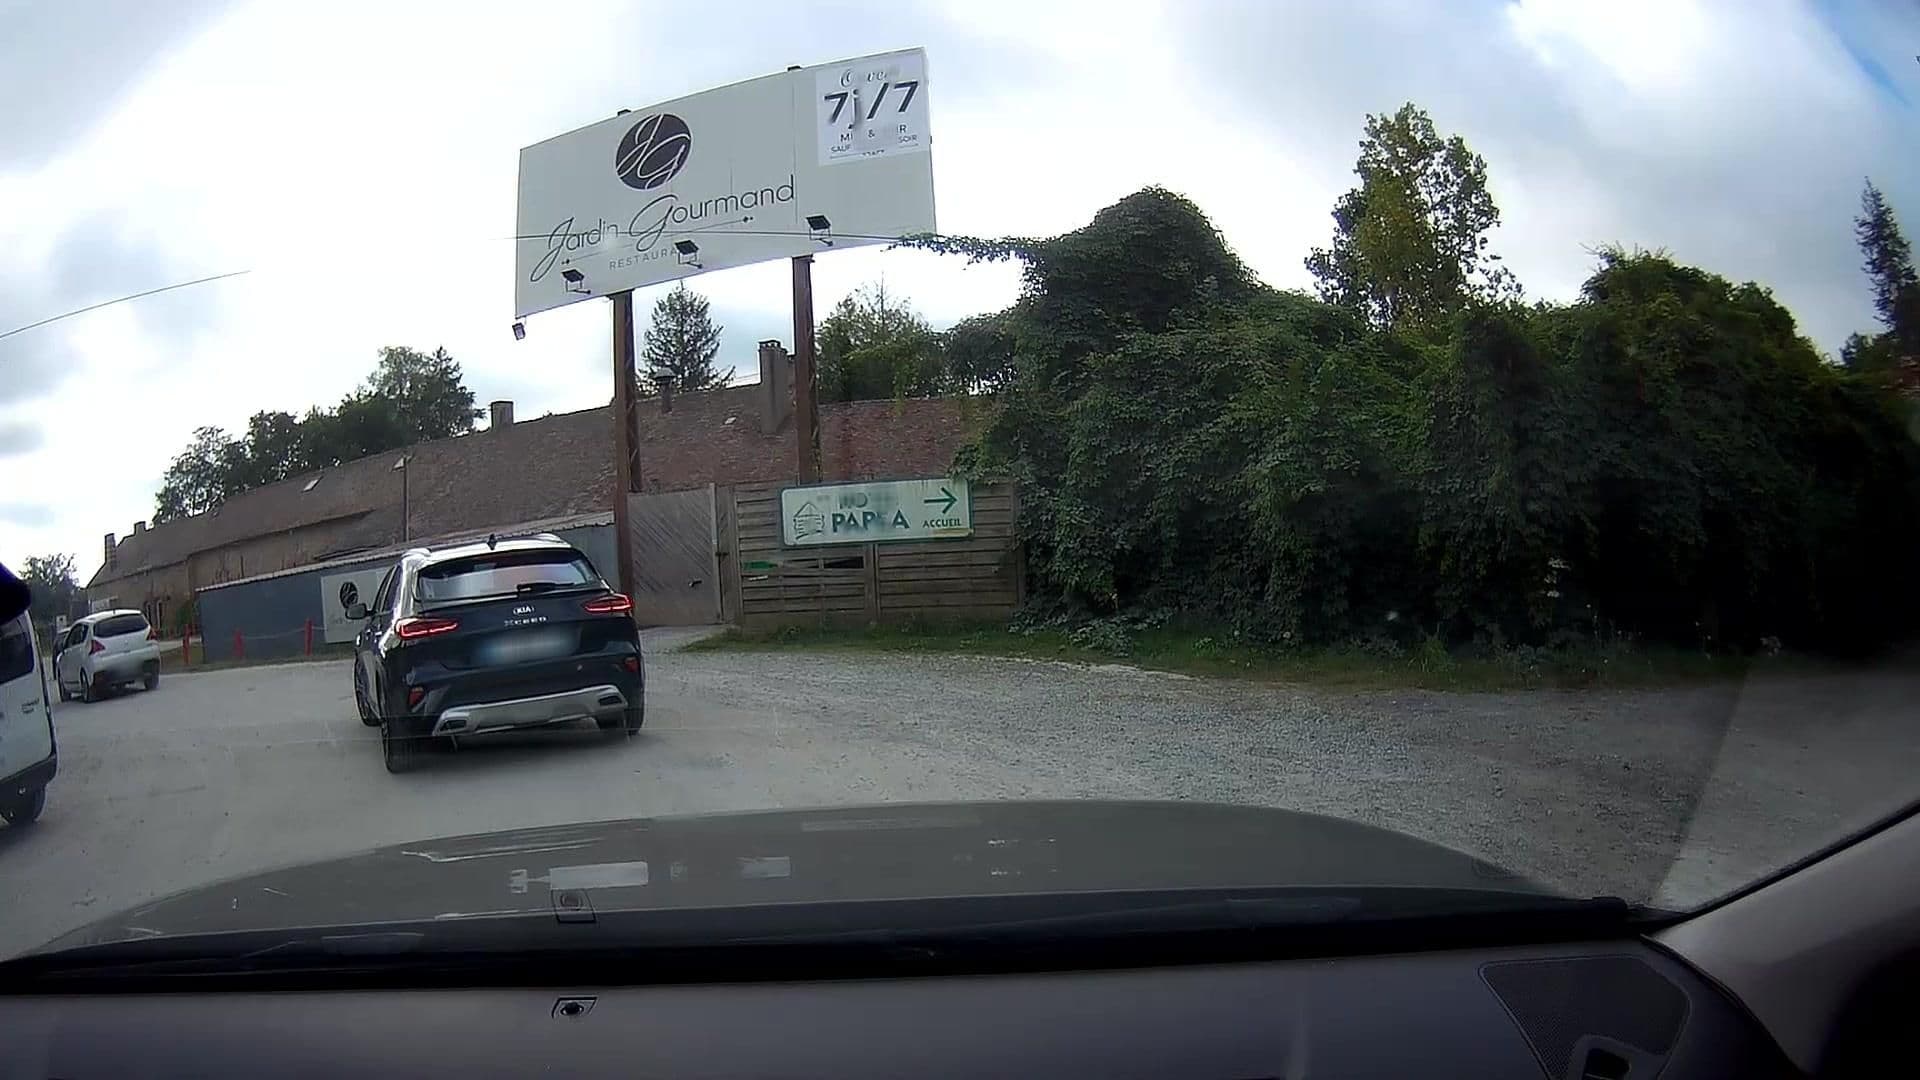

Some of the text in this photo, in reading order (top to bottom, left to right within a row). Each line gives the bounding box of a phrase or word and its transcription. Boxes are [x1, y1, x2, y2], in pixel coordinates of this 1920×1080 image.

[530, 174, 795, 282] Jardin Gourmand
[609, 247, 681, 270] RESTAURA
[831, 508, 961, 533] PAPA ACCUEIL
[515, 605, 532, 614] KIA
